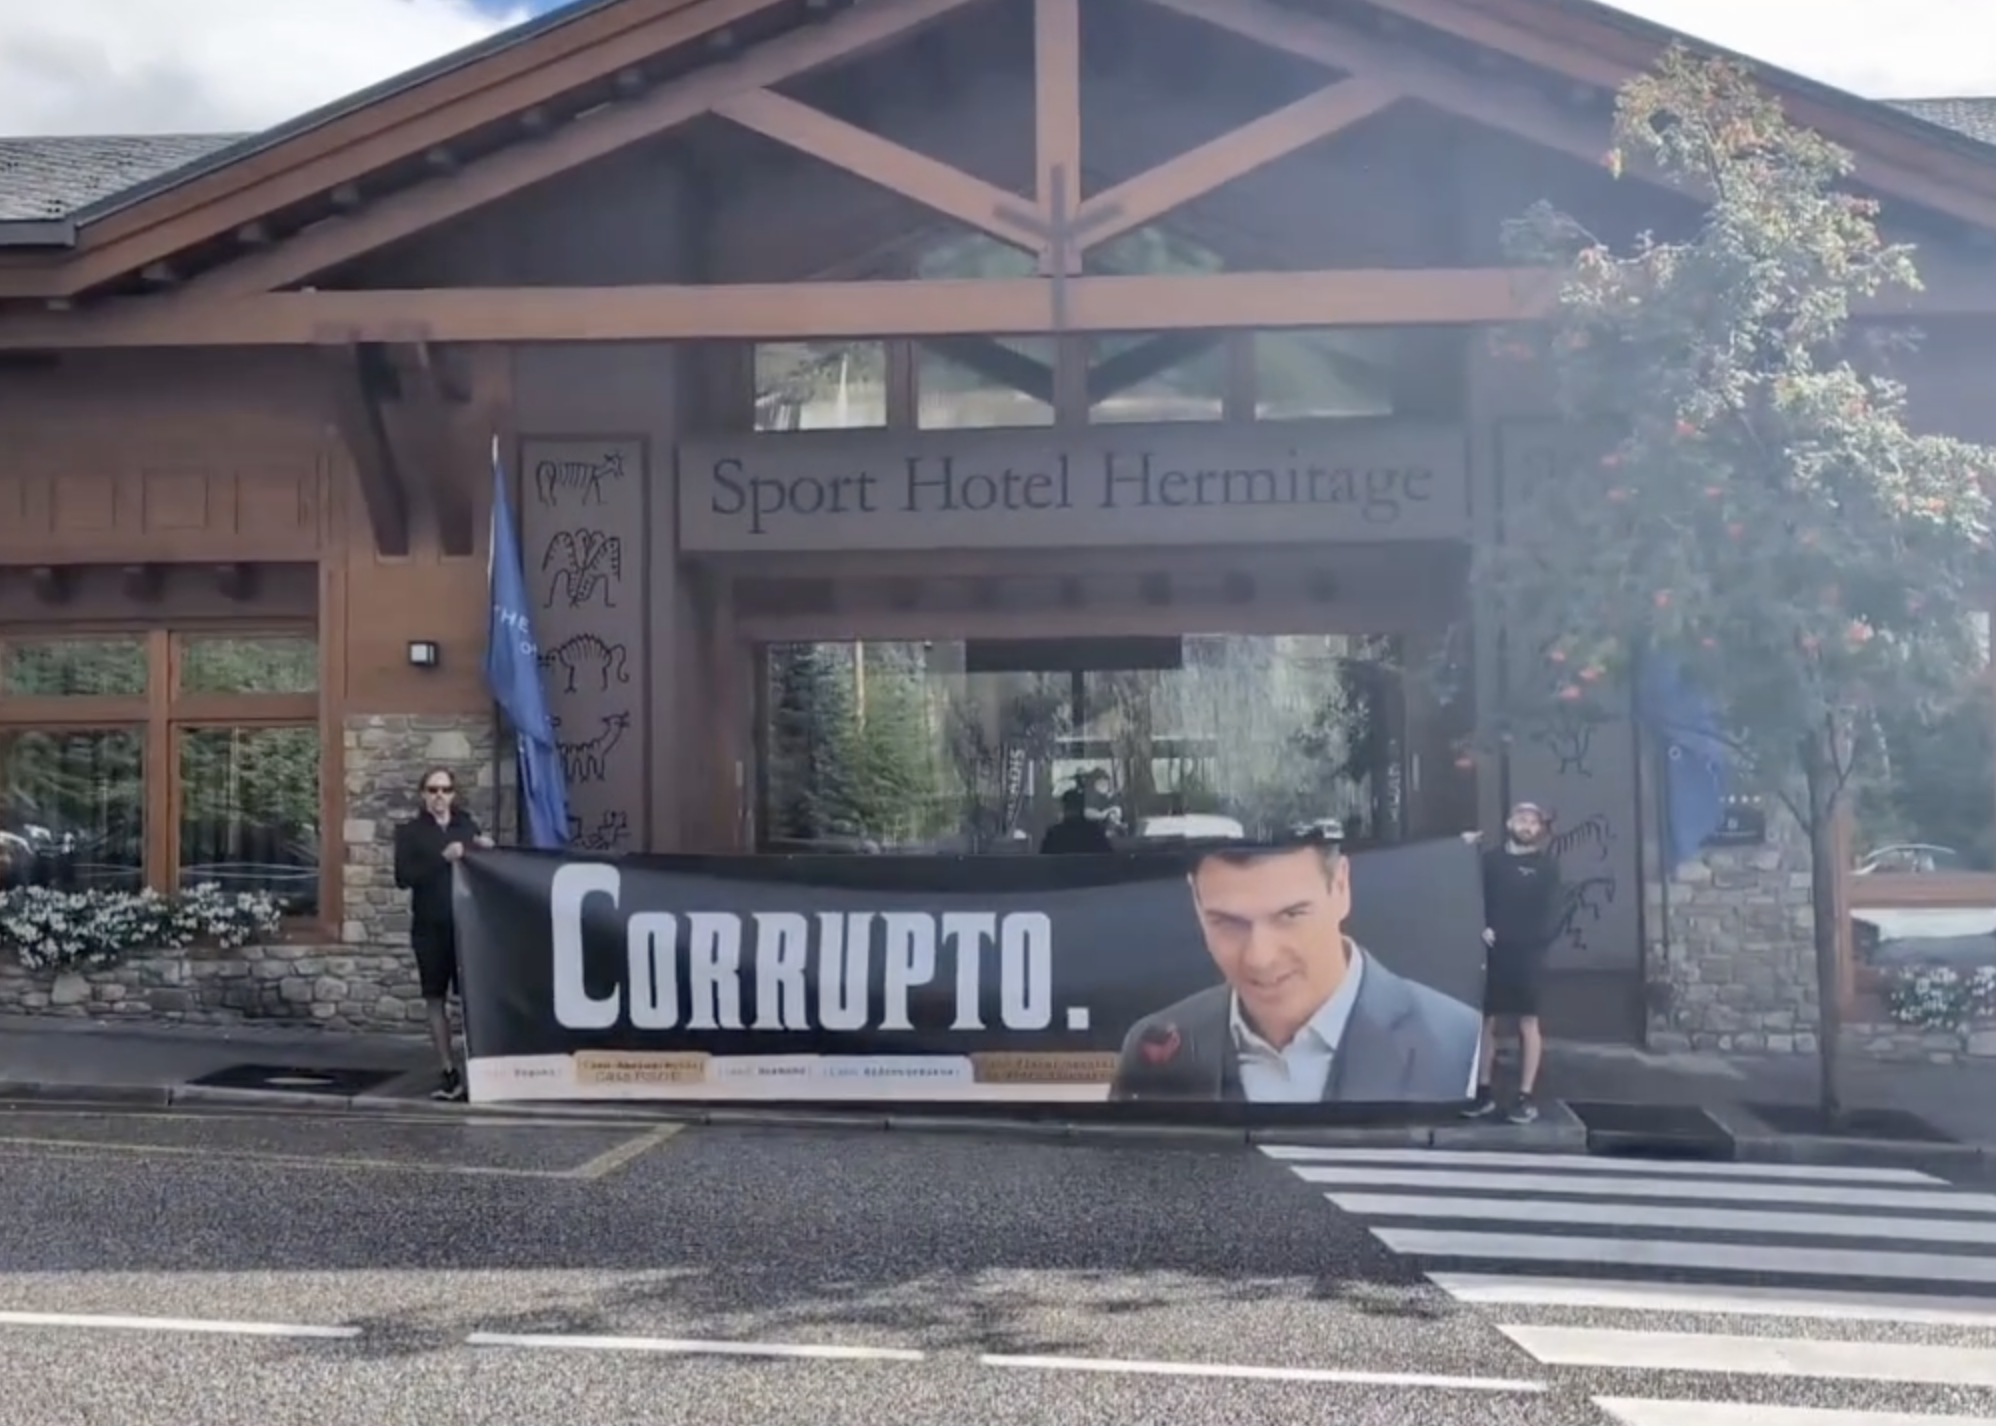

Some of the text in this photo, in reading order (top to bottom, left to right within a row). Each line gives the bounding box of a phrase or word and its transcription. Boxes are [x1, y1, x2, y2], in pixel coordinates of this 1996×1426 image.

[711, 449, 1434, 534] Sport Hotel Hermitage
